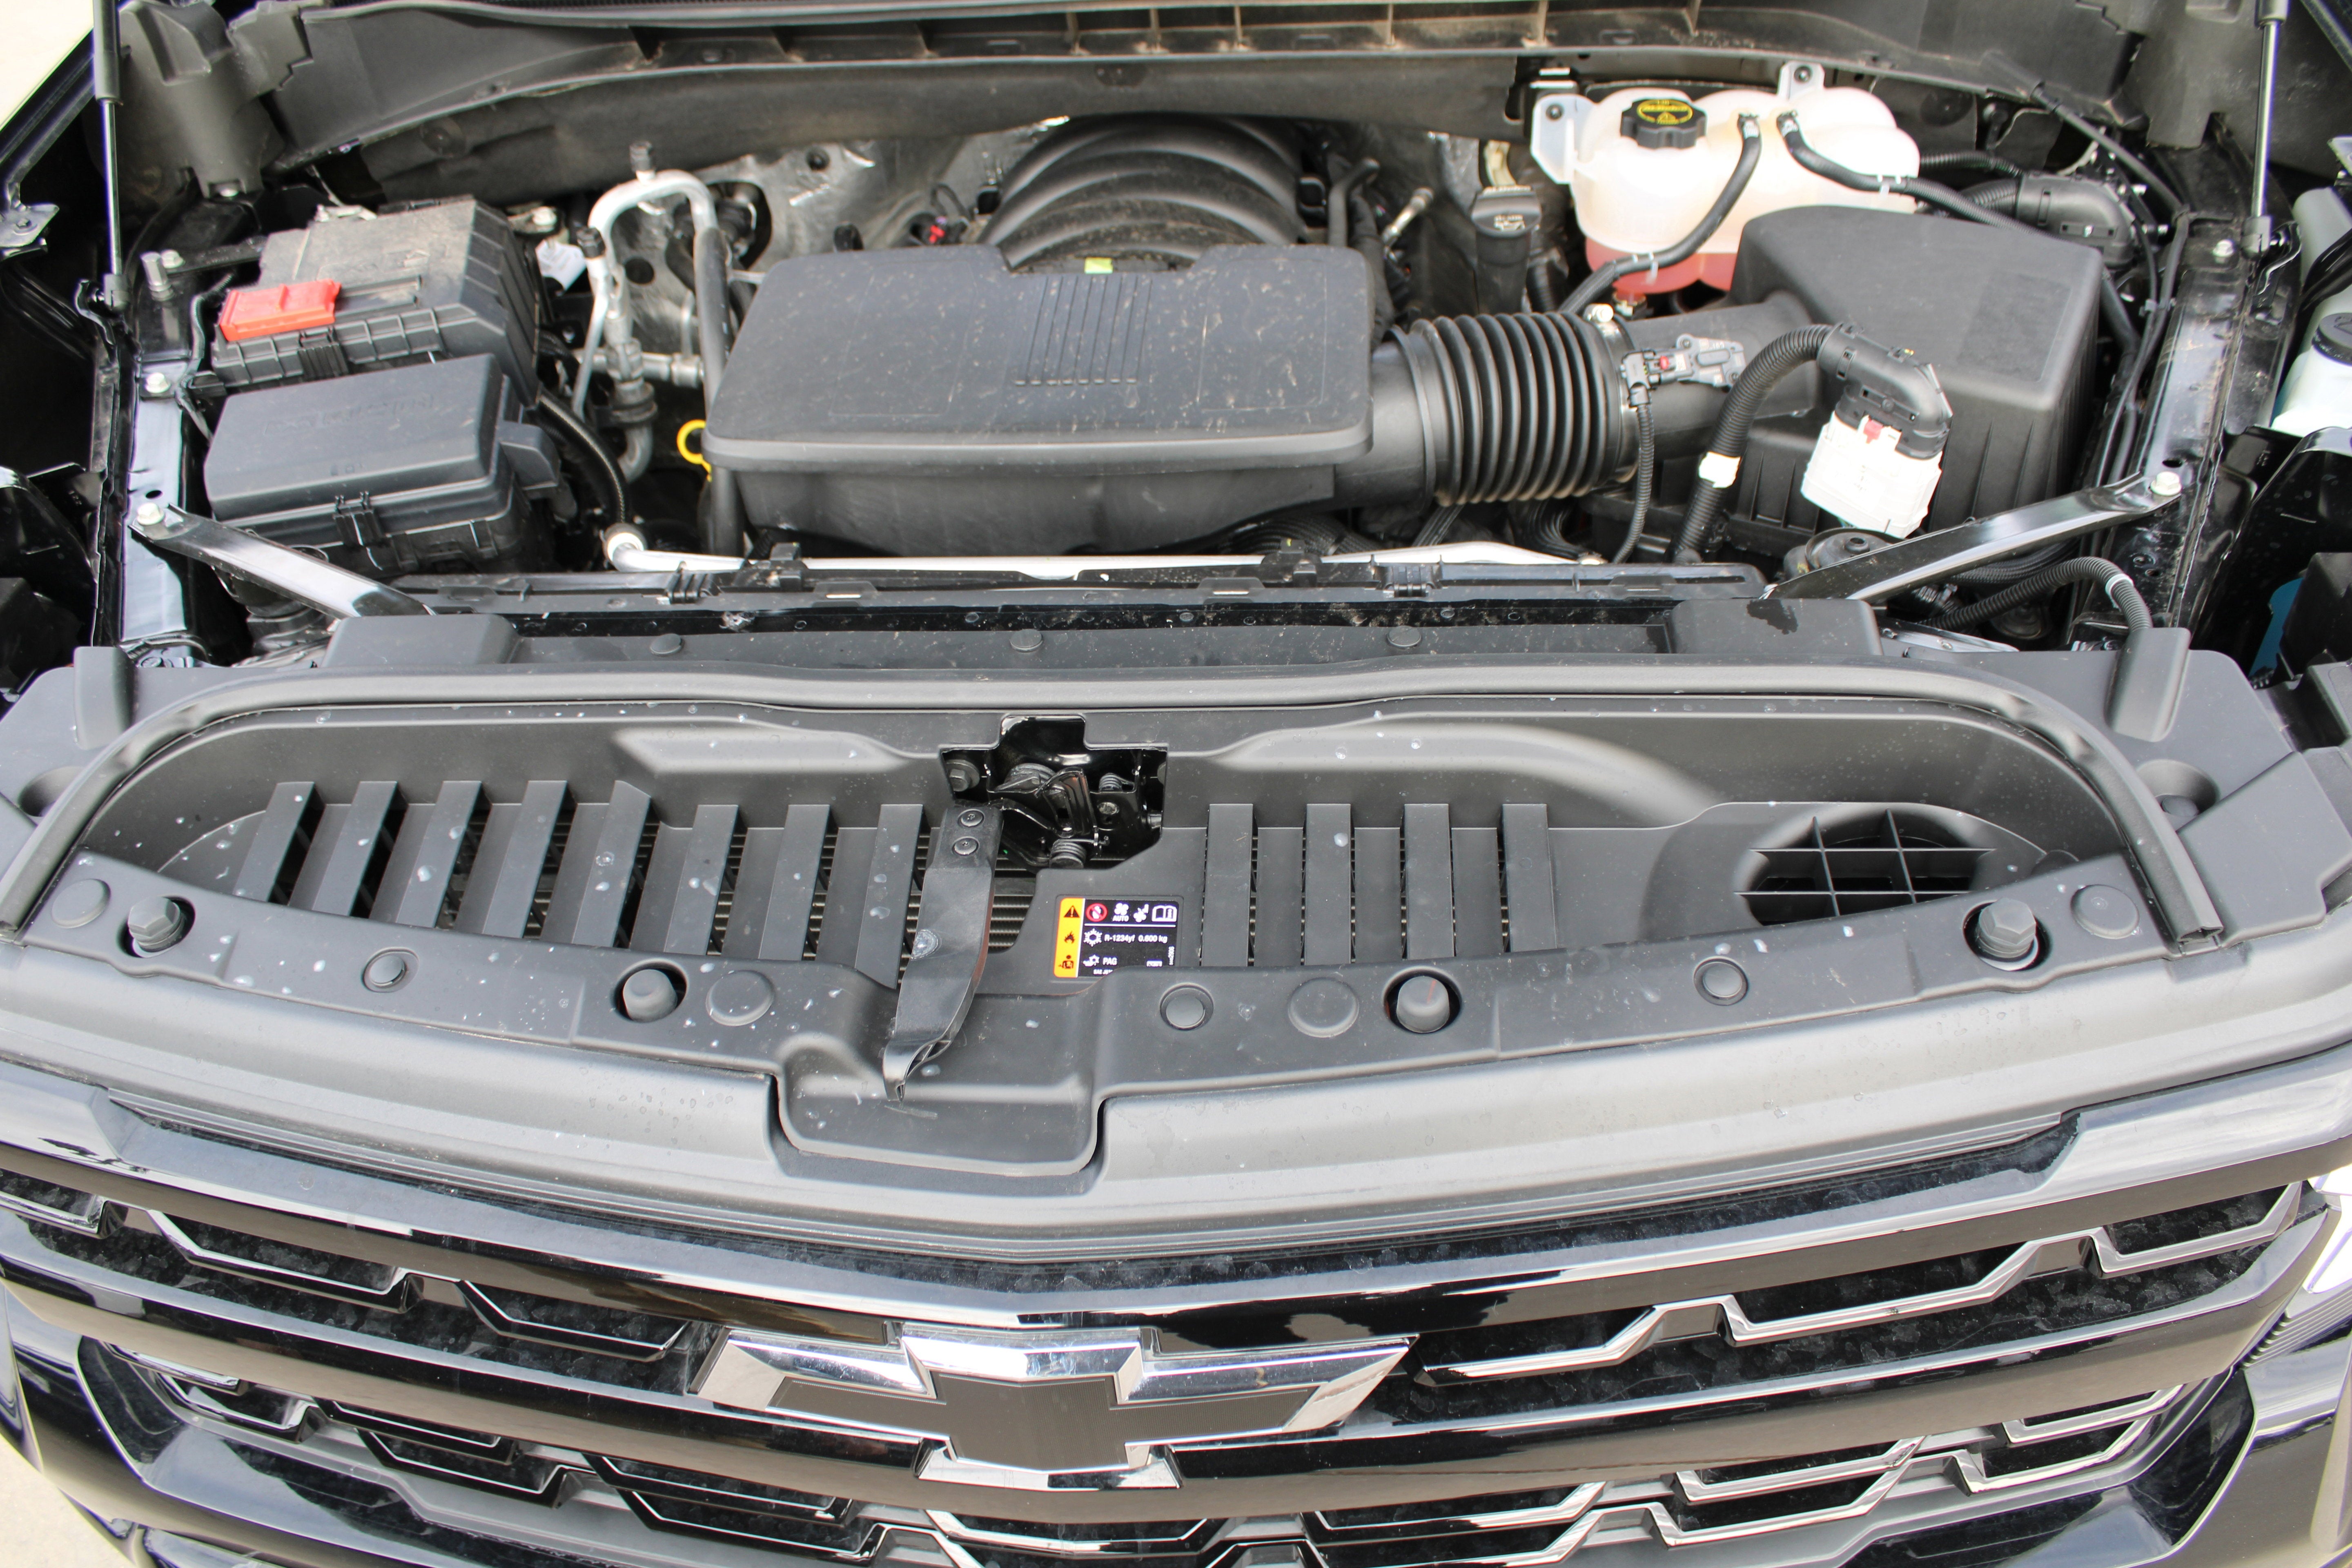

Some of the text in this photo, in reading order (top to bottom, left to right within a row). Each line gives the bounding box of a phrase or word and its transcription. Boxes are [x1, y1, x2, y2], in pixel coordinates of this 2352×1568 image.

[1104, 934, 1135, 943] R-1234yf
[1158, 935, 1168, 944] kg
[1103, 957, 1117, 965] PAG
